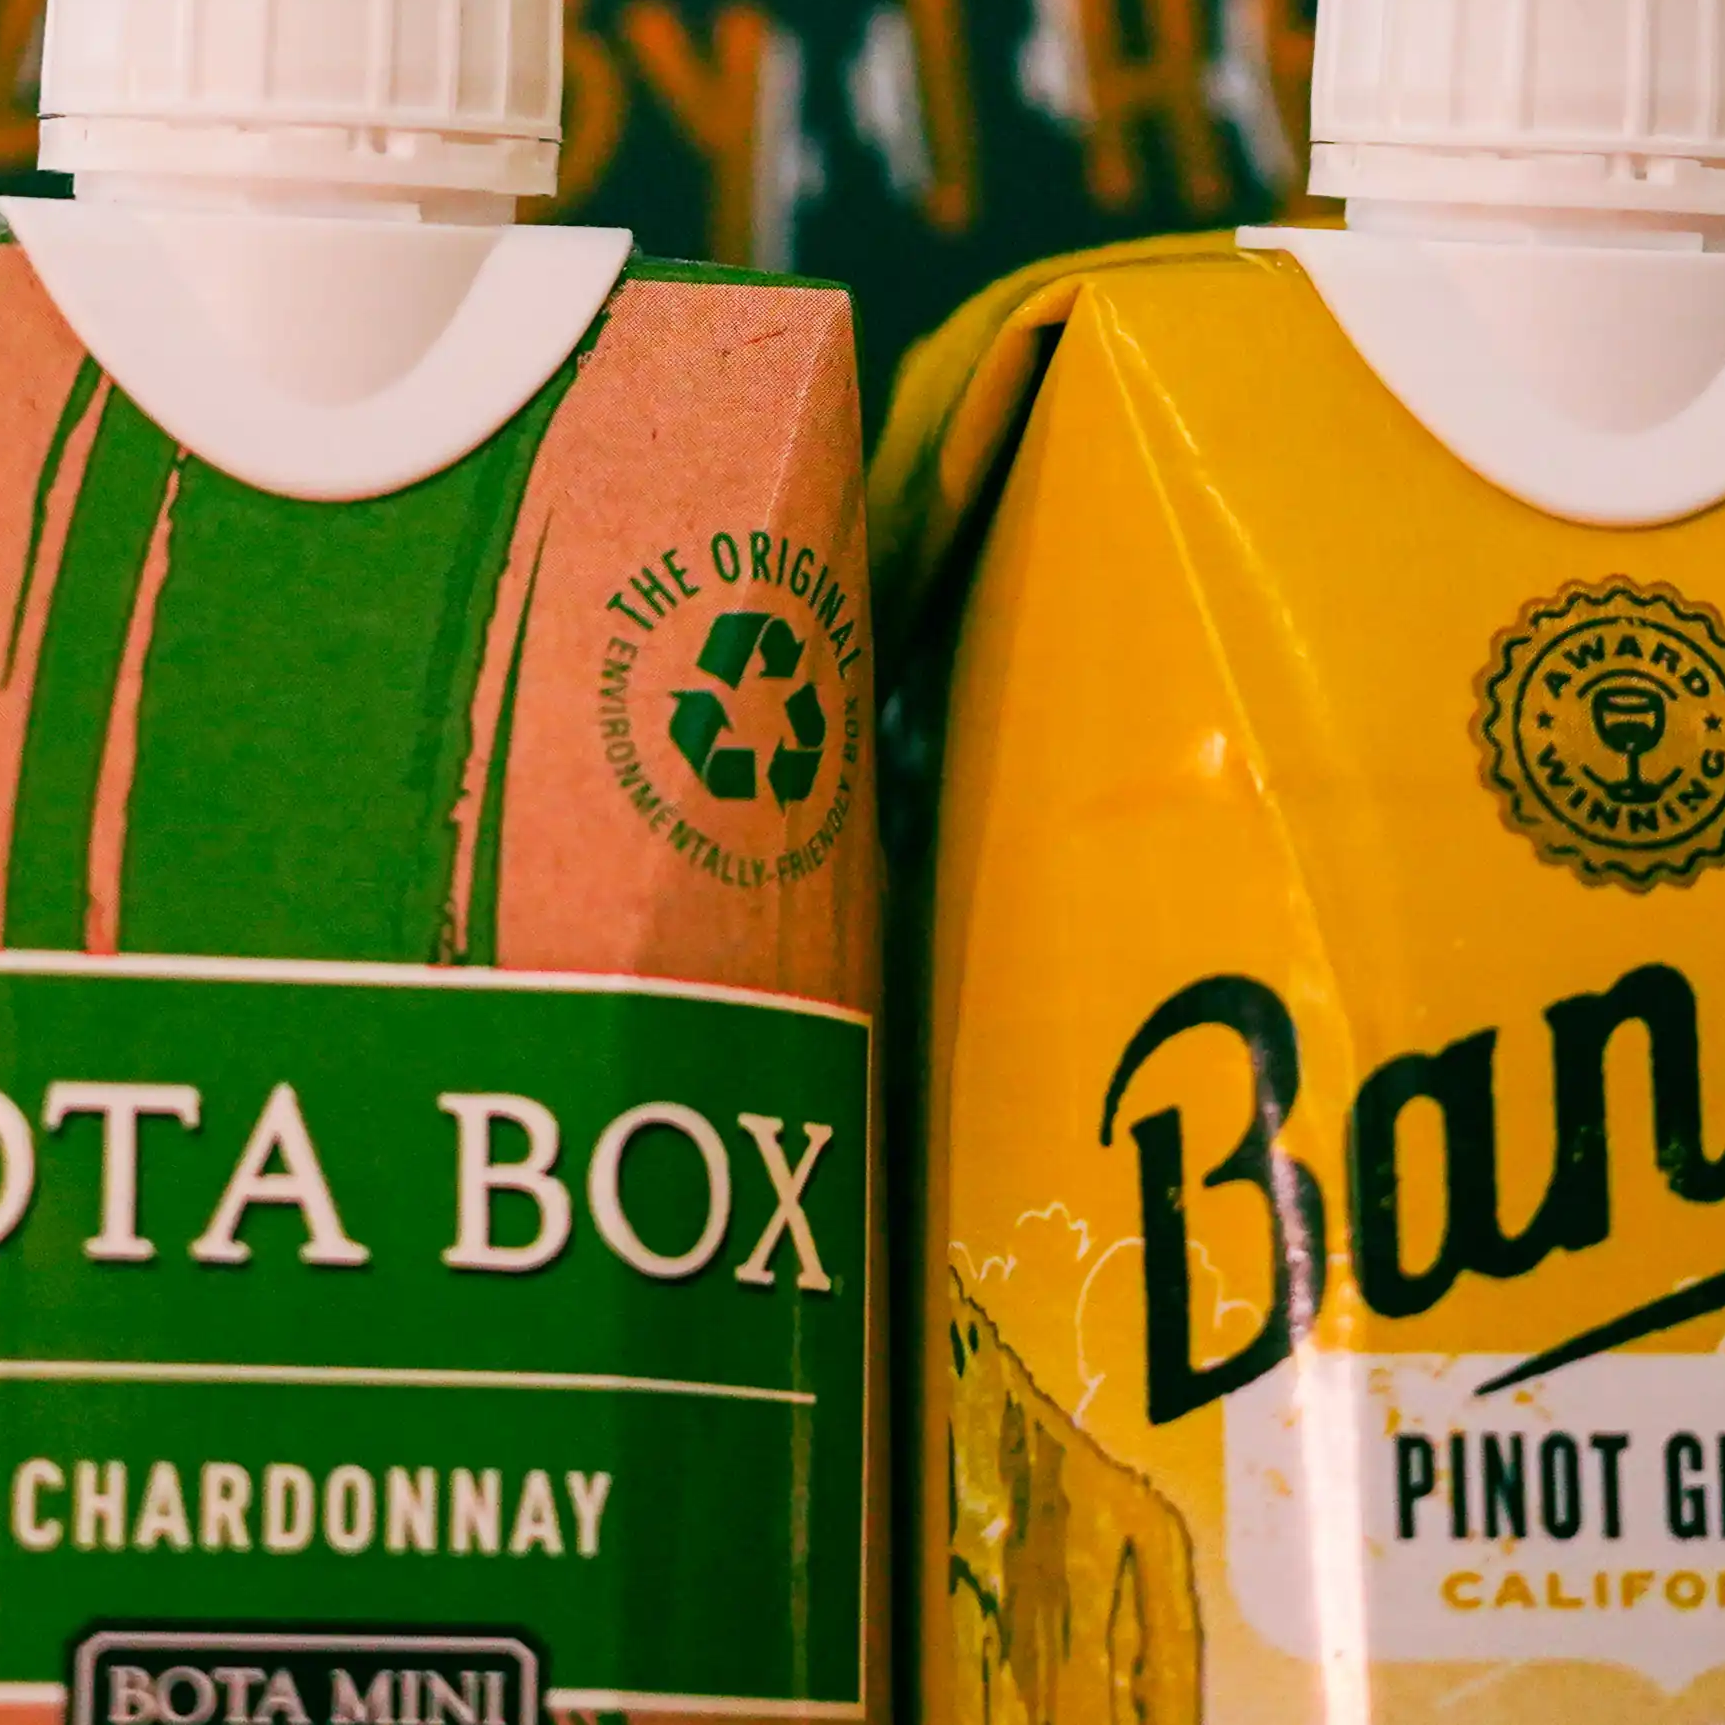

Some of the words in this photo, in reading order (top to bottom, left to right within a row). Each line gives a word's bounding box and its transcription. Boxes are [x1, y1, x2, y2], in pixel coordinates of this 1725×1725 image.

[607, 549, 700, 631] THE
[710, 531, 862, 680] ORIGINAL
[1543, 634, 1710, 699] AWARD
[1537, 742, 1725, 833] WINNING
[436, 1090, 836, 1293] BOX
[9, 1456, 614, 1558] CHARDONNAY
[1393, 1431, 1629, 1541] PINOT
[108, 1665, 312, 1725] BOTA
[329, 1668, 507, 1725] MINI
